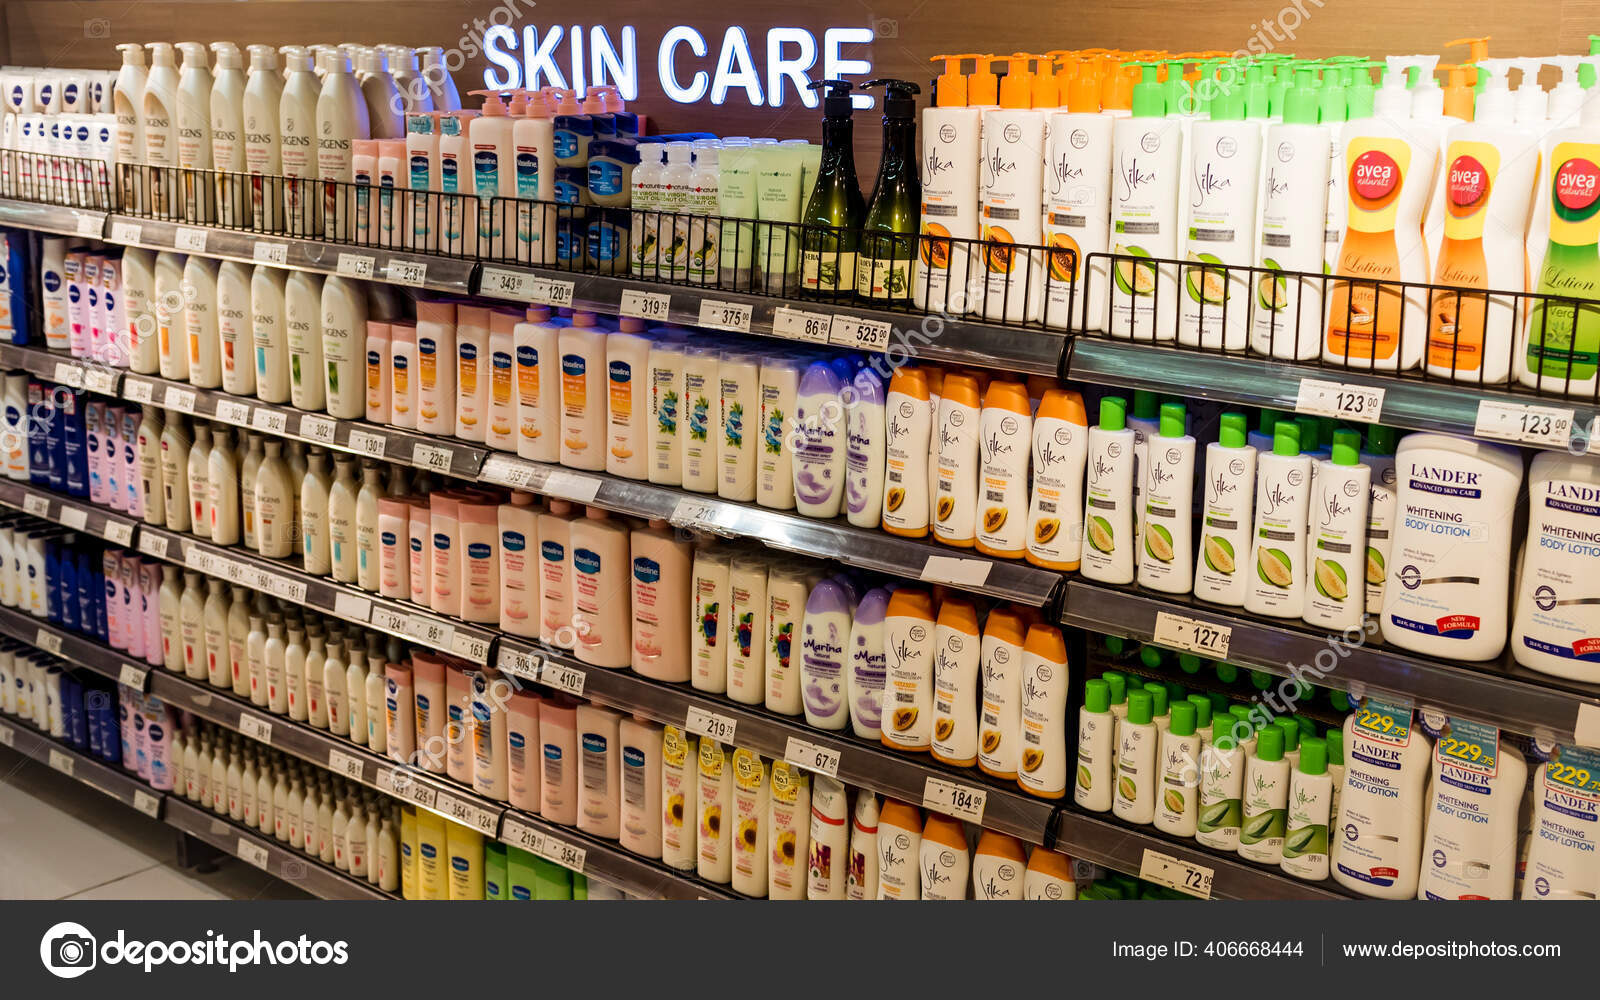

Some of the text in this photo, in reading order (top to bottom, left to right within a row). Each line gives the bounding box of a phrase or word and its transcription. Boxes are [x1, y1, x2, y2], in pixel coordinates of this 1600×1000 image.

[483, 24, 875, 110] SKIN CARE
[922, 137, 954, 186] Silka
[985, 138, 1017, 188] Silka
[1051, 143, 1084, 195] Silka
[1120, 150, 1156, 202] Silka
[1356, 163, 1391, 179] avea
[1451, 168, 1481, 184] avea
[1559, 172, 1596, 188] avea
[1192, 154, 1231, 207] Silka
[1356, 175, 1389, 187] naturals
[1559, 185, 1593, 197] naturals
[1344, 253, 1393, 276] Lotion
[1440, 262, 1481, 284] Lotion
[404, 267, 418, 281] 218
[500, 276, 516, 290] 343
[1544, 266, 1595, 291] Lotion
[549, 286, 564, 300] 120
[642, 299, 667, 314] 319 75
[722, 310, 749, 325] 375 00
[805, 320, 827, 335] 86 00
[857, 326, 886, 342] 525 00
[563, 359, 584, 369] Vaseline
[610, 368, 630, 377] Vaseline
[1337, 393, 1378, 413] 123 00
[268, 415, 280, 429] 302
[316, 422, 329, 437] 302
[795, 424, 834, 437] Marina
[888, 415, 909, 446] Silka
[1521, 414, 1566, 435] 123 00
[365, 438, 378, 451] 130
[938, 424, 959, 454] Silka
[984, 424, 1012, 464] Silka
[429, 452, 444, 466] 226
[1037, 432, 1066, 475] Silka
[1090, 449, 1115, 484] Silka
[1149, 456, 1174, 491] Silka
[1411, 463, 1478, 485] LANDER
[1210, 464, 1237, 504] Silka
[1412, 482, 1476, 497] ADVANCED SKIN CARE
[1264, 472, 1295, 515] Silka
[1321, 485, 1351, 526] Silka
[1406, 504, 1463, 523] WHITENING
[1549, 500, 1598, 515] ADVANCED SKIN
[1405, 518, 1471, 537] BODY LOTION
[503, 536, 524, 545] Vaseline
[1540, 537, 1566, 551] BODY
[543, 545, 563, 556] Vaseline
[575, 554, 599, 568] Vaseline
[635, 564, 659, 575] Vaseline
[388, 617, 400, 630] 124
[428, 626, 438, 639] 86
[1443, 621, 1476, 630] FORMULA
[804, 639, 842, 653] Marina
[1193, 627, 1230, 647] 127 00
[470, 643, 483, 658] 163
[891, 632, 921, 669] Silka
[937, 638, 958, 677] Silka
[516, 657, 530, 673] 309
[982, 657, 1005, 688] Silka
[560, 672, 576, 688] 410
[1023, 673, 1048, 707] Silka
[707, 719, 733, 737] 219 75
[583, 738, 607, 748] Vaseline
[1353, 740, 1400, 761] LANDER
[815, 752, 838, 768] 67 00
[1440, 756, 1458, 766] Certified
[1350, 768, 1390, 786] WHITENING
[1441, 763, 1489, 785] LANDER
[414, 788, 427, 799] 225
[1349, 778, 1398, 798] BODY LOTION
[951, 790, 982, 808] 184 00
[1438, 792, 1479, 811] WHITENING
[1545, 789, 1596, 812] LANDER
[453, 804, 466, 818] 354
[1437, 803, 1488, 824] BODY LOTION
[478, 815, 491, 829] 124
[1541, 818, 1585, 839] WHITENING
[521, 831, 536, 847] 219
[1539, 829, 1595, 852] BODY LOTION
[561, 848, 576, 863] 354
[881, 838, 905, 872] Silka
[924, 853, 951, 890] Silka
[1185, 869, 1202, 888] 72
[1204, 876, 1213, 885] 00
[980, 868, 1010, 900] Silka
